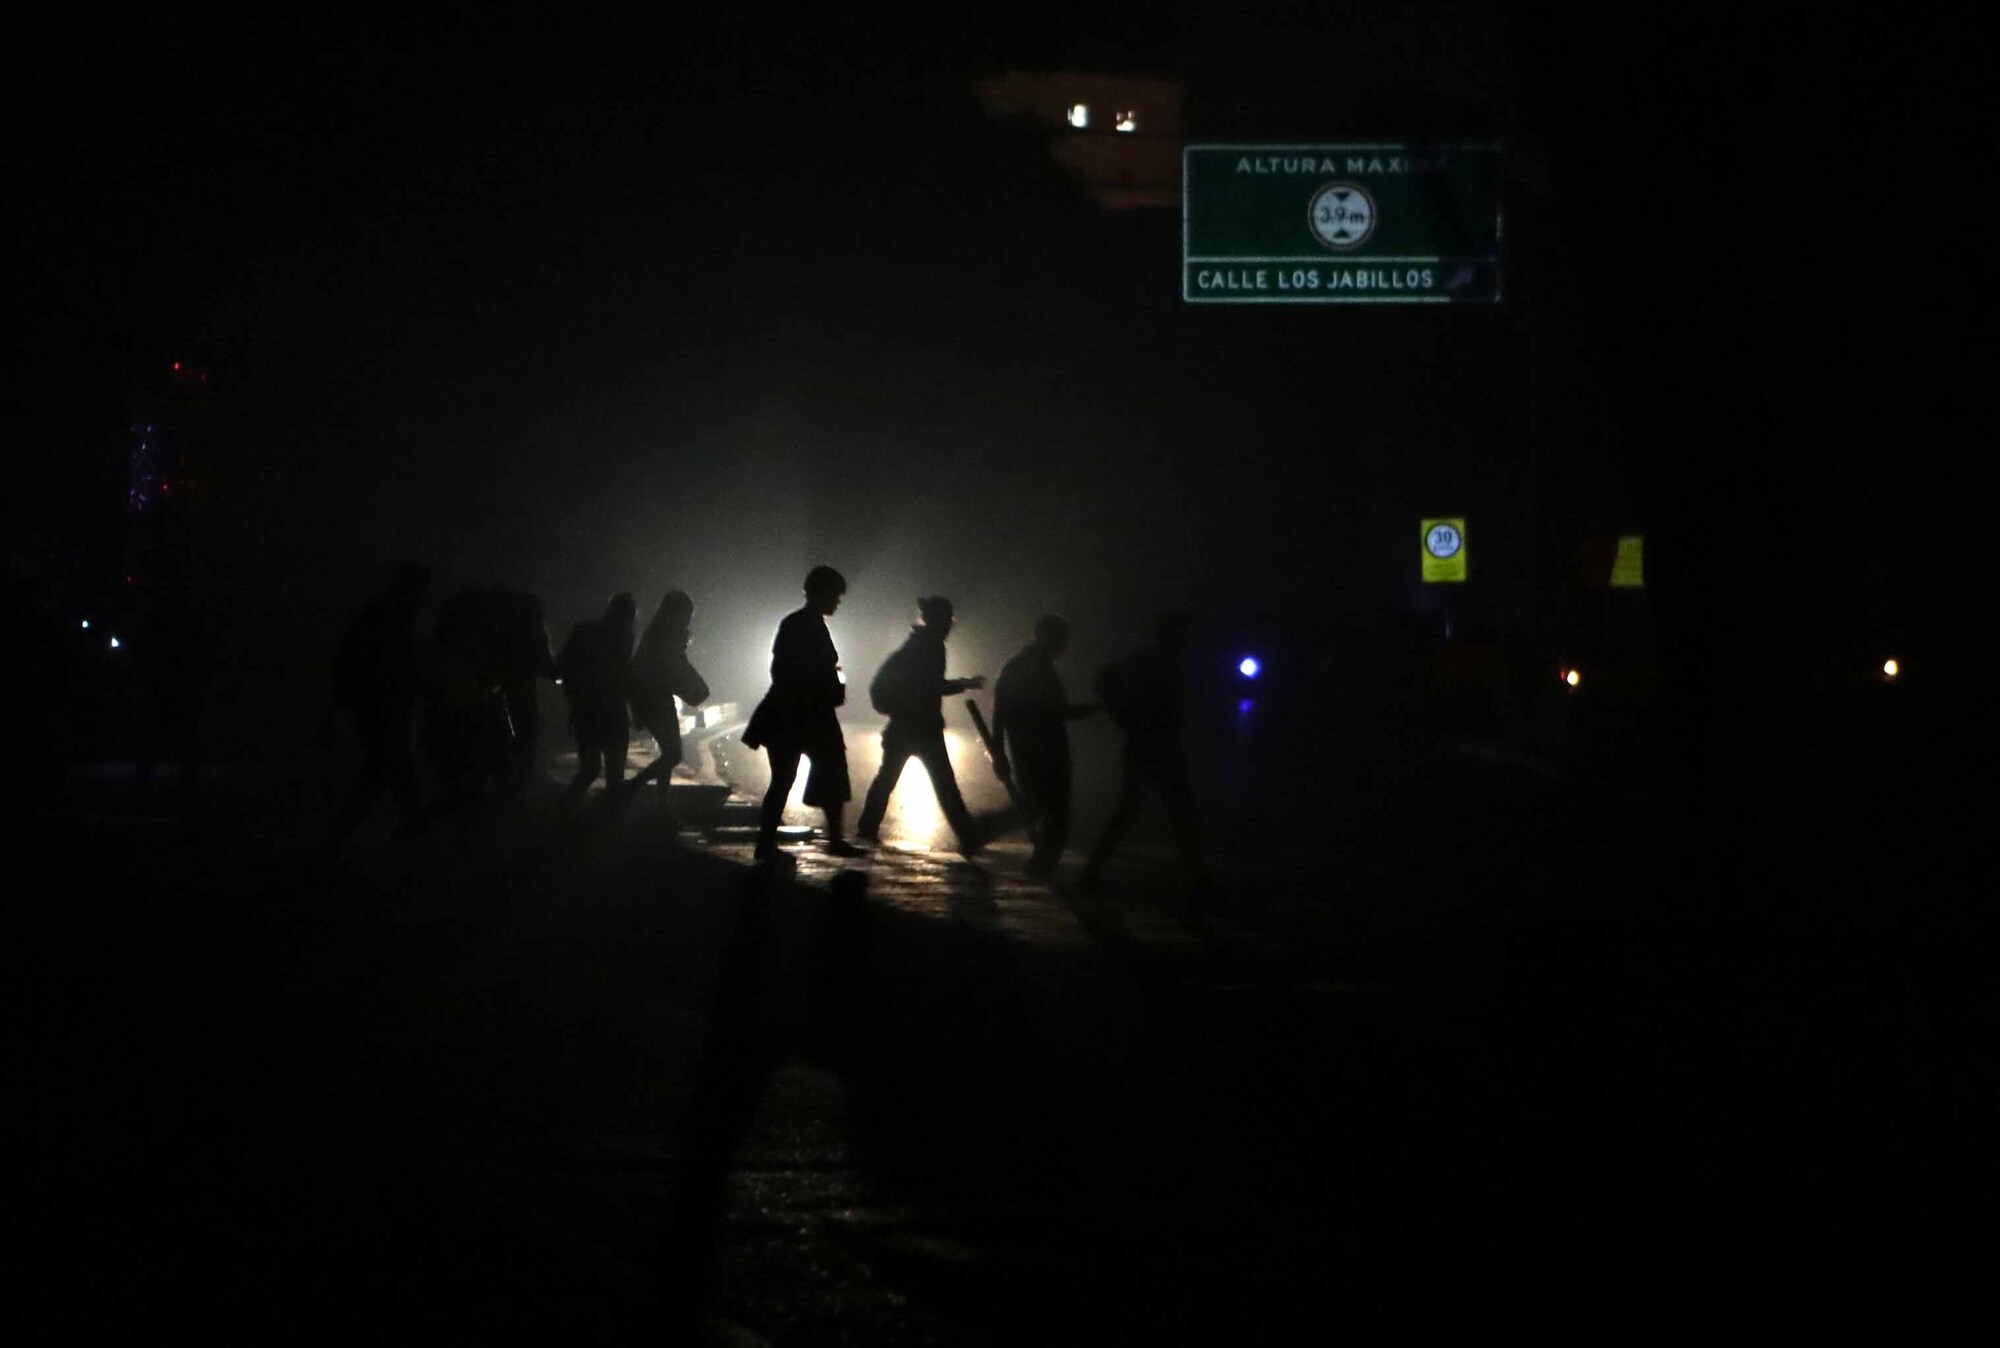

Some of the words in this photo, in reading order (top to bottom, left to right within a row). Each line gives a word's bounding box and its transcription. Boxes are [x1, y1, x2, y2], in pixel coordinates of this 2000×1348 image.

[1236, 156, 1335, 175] ALTURA
[1346, 156, 1451, 175] MAXI
[1197, 270, 1269, 290] CALLE
[1277, 270, 1320, 290] LOS
[1327, 270, 1435, 290] JABILLOS
